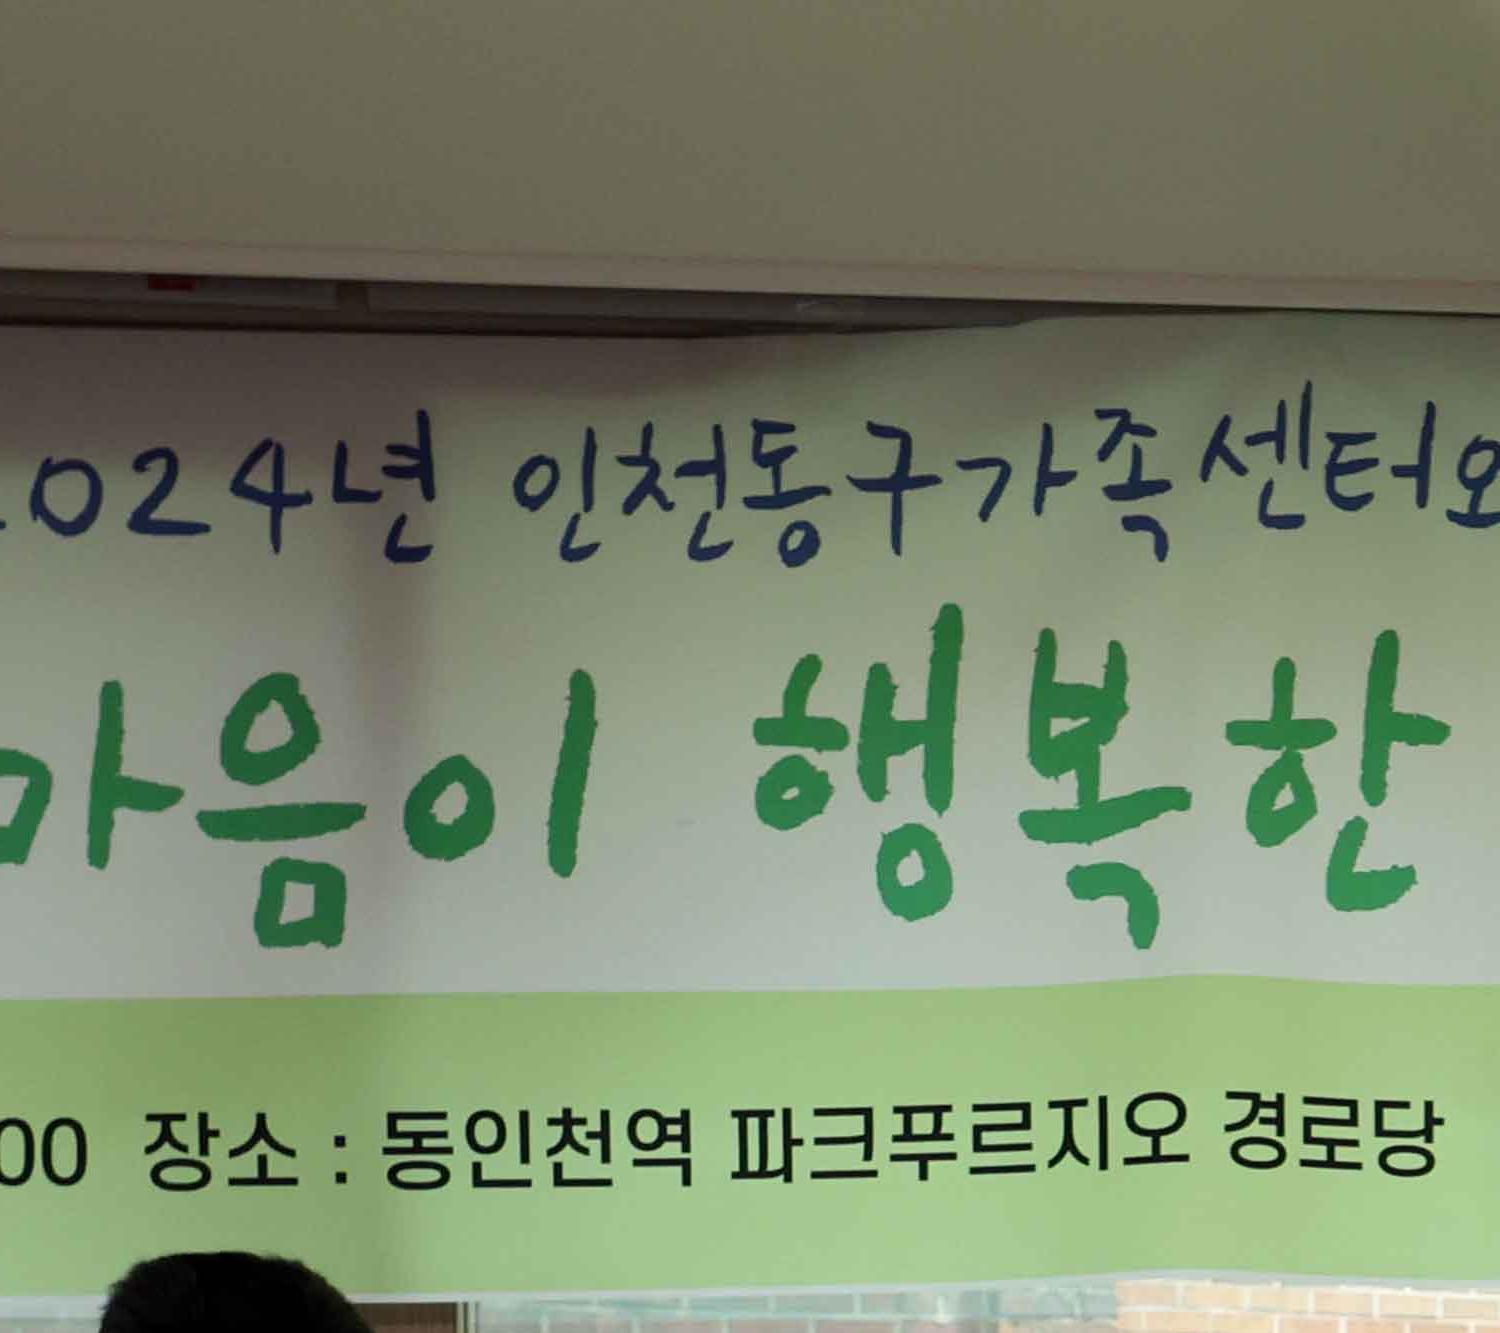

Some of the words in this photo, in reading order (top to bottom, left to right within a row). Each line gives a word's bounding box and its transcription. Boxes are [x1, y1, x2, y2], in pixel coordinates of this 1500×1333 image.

[751, 602, 1453, 951] 행복한
[143, 1110, 300, 1193] 장소
[381, 1106, 695, 1191] 동인천역
[730, 1090, 1191, 1185] 파크푸르지오
[1222, 1089, 1445, 1178] 경로당
